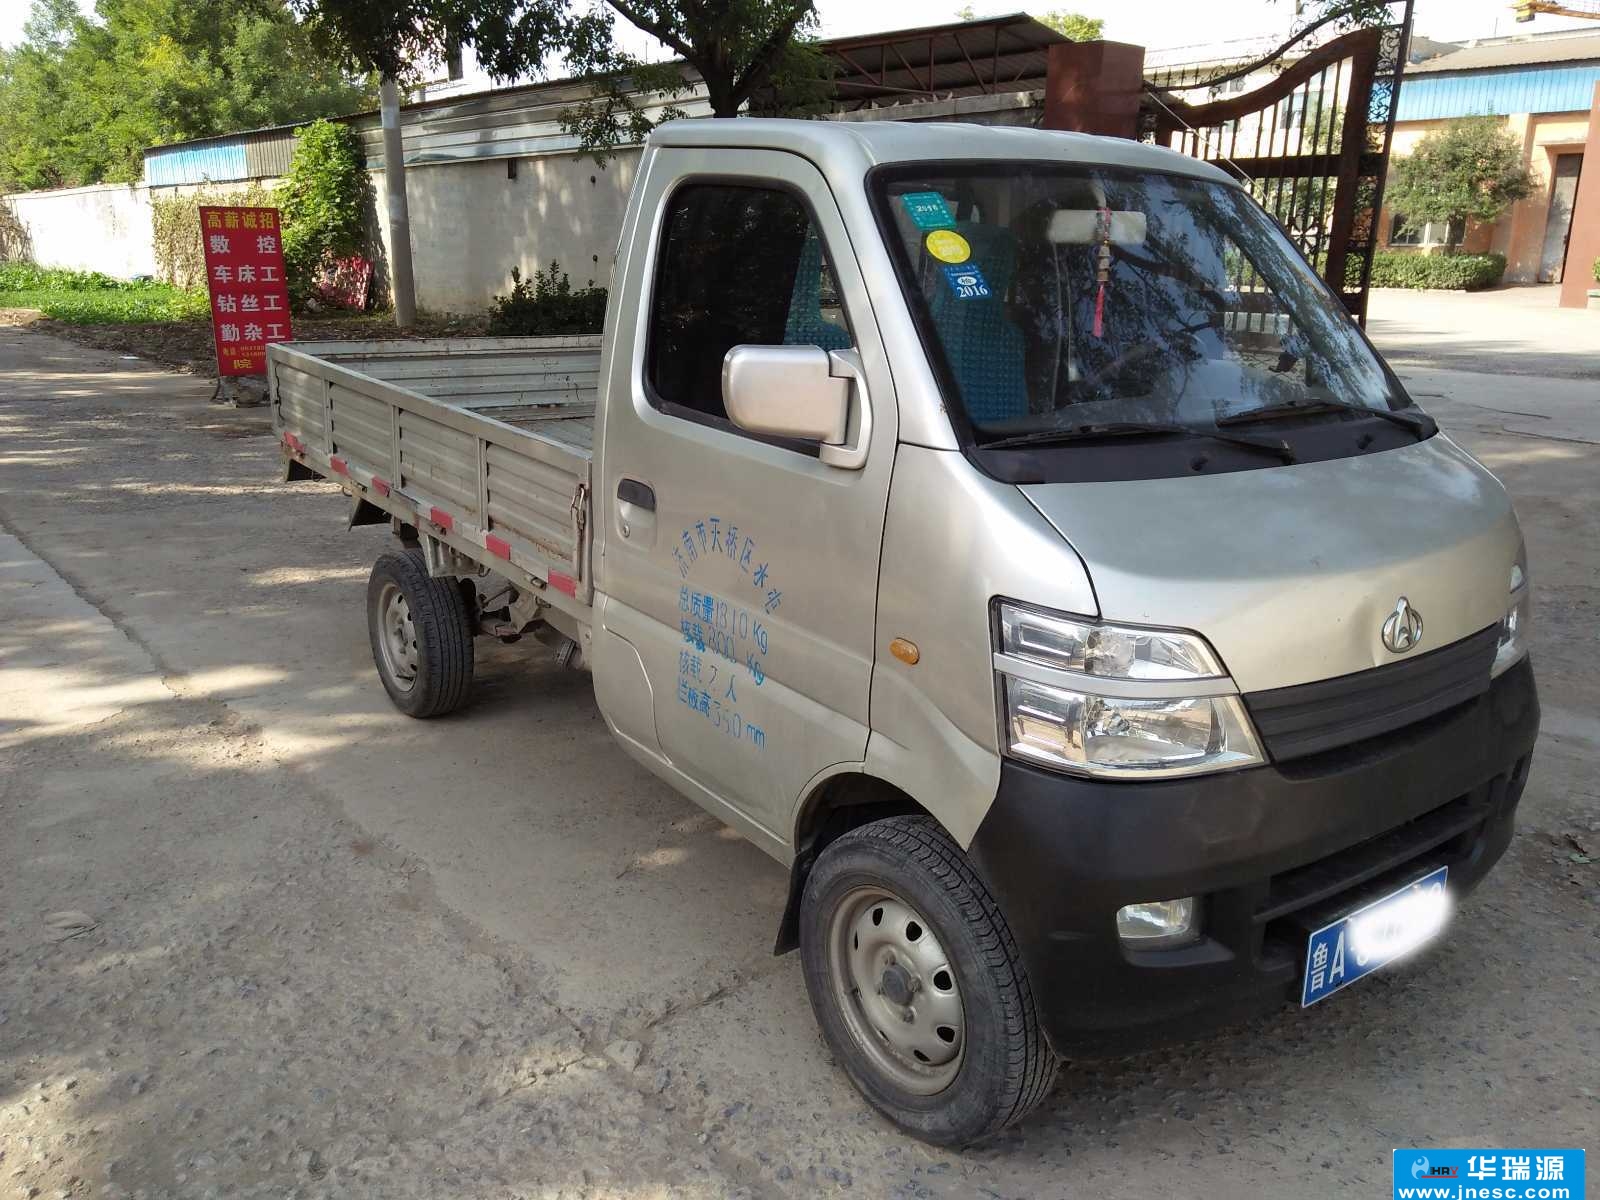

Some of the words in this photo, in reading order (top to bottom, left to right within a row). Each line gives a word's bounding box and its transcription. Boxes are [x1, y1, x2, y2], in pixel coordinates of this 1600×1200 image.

[206, 212, 275, 229] 高薪诚招
[210, 235, 277, 254] 数控
[213, 265, 280, 284] 车床工
[956, 285, 988, 298] 2016
[217, 294, 283, 313] 钻丝工
[220, 323, 286, 342] 勤杂工
